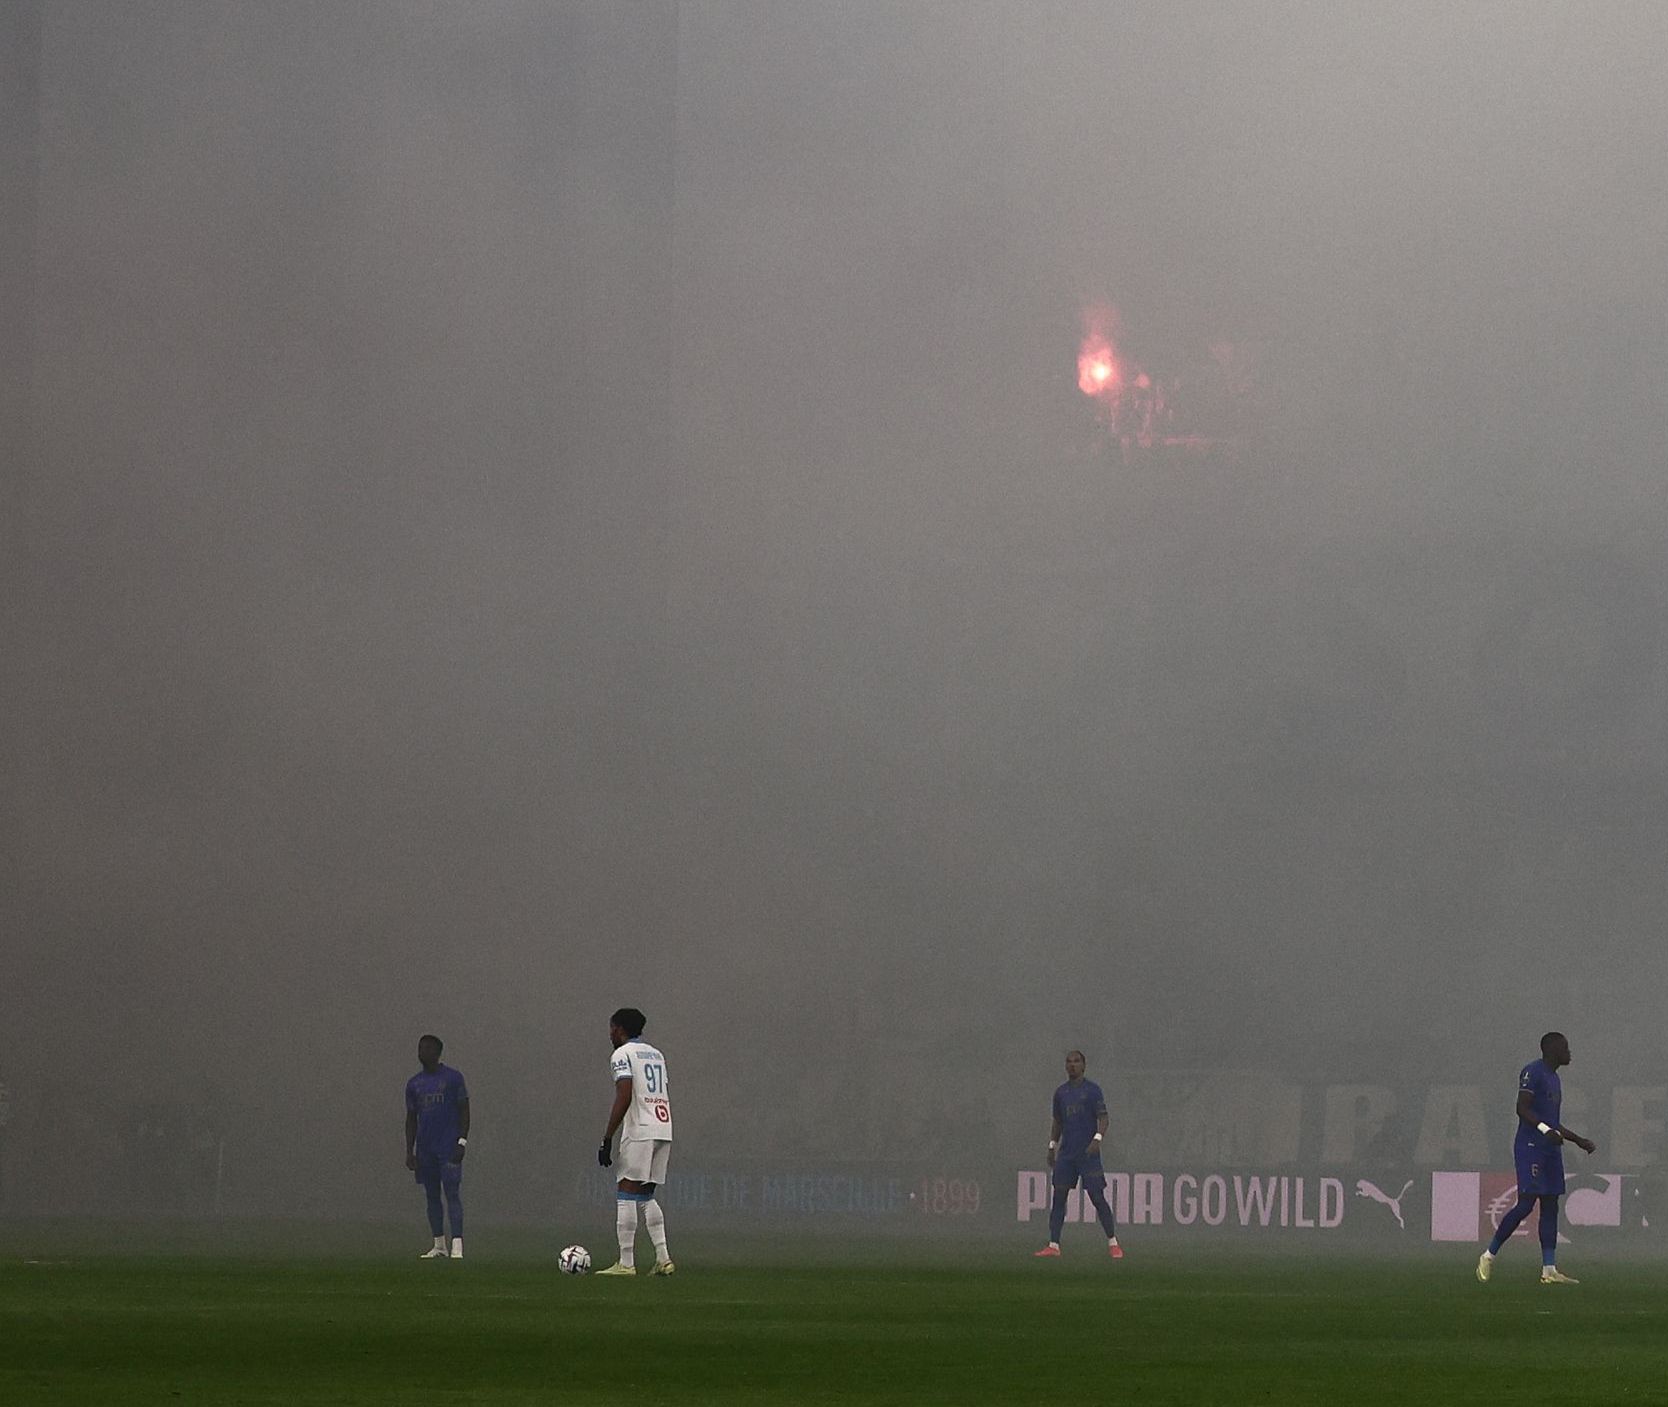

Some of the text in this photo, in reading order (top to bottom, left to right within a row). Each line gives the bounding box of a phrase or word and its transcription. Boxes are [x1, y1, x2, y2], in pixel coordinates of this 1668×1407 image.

[644, 1063, 663, 1093] 97
[919, 1178, 981, 1214] 1899
[1017, 1170, 1164, 1225] PMA
